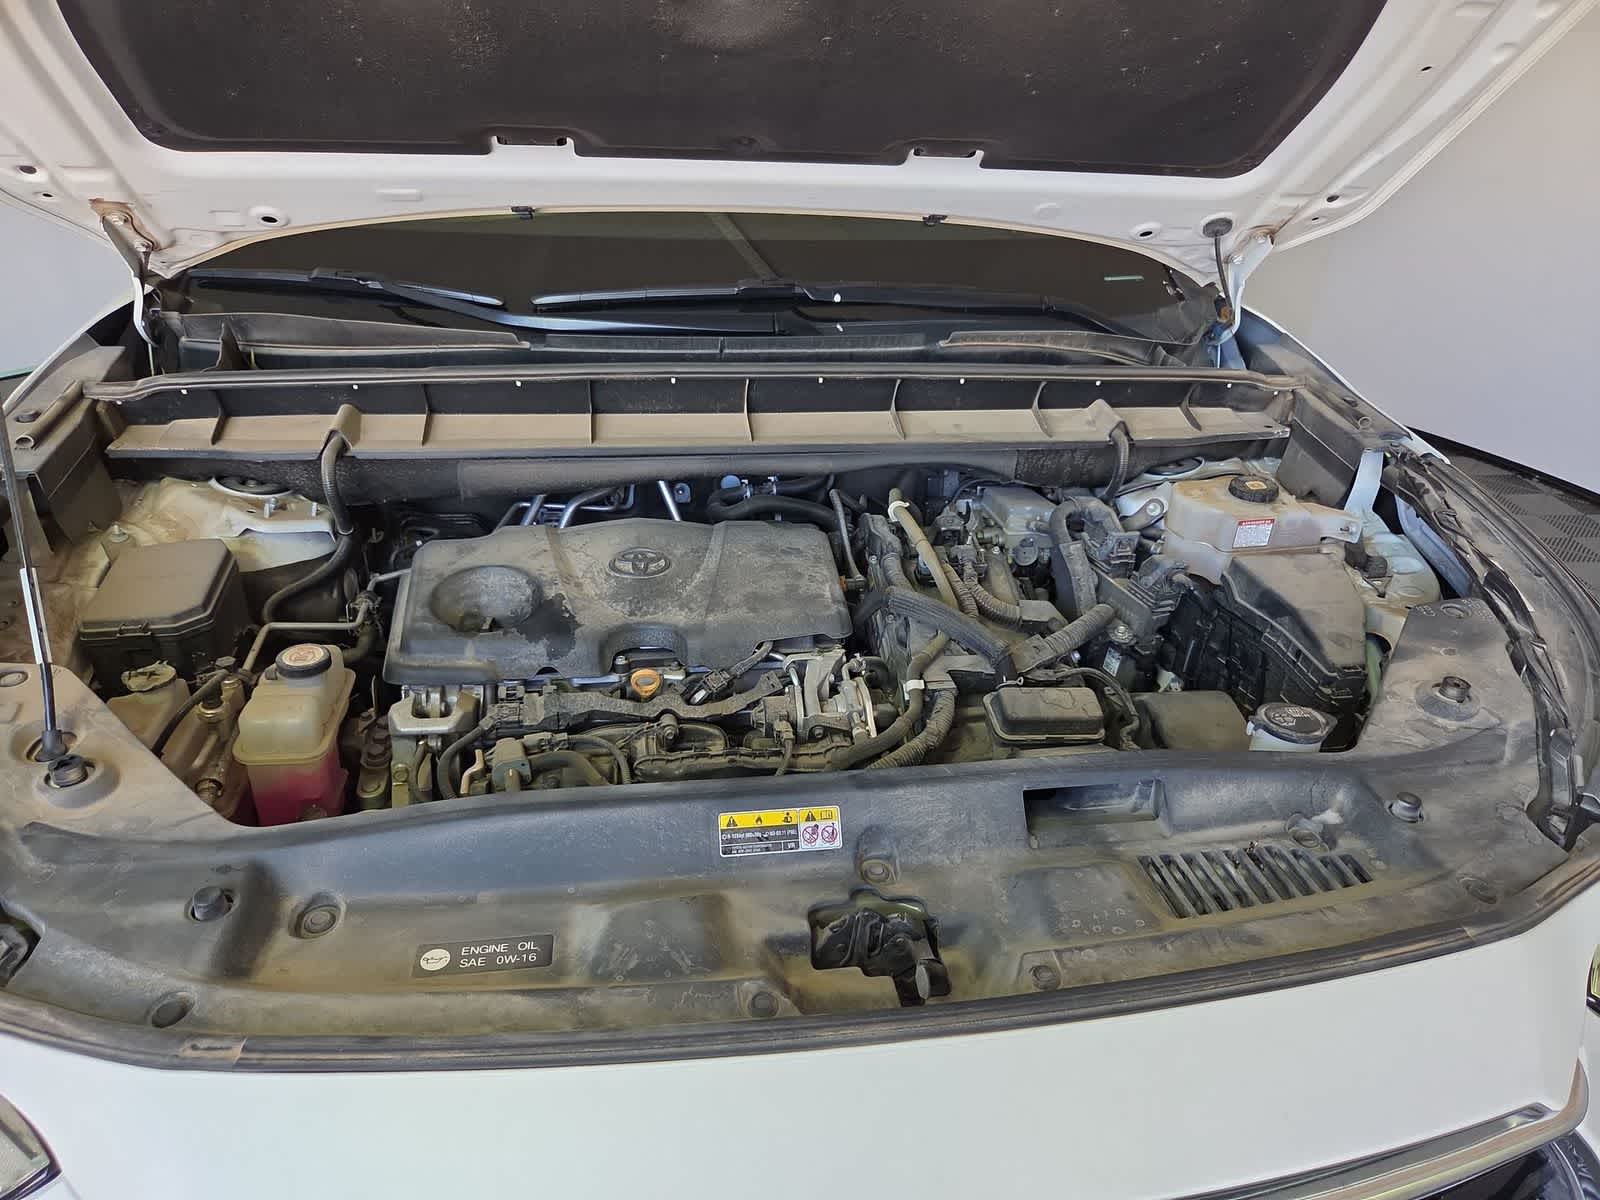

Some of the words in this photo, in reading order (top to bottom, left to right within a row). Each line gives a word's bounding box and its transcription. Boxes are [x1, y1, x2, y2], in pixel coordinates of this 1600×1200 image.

[461, 944, 509, 955] ENGINE
[518, 941, 538, 950] OIL
[459, 957, 486, 968] SAE
[496, 952, 537, 964] 0W-16
